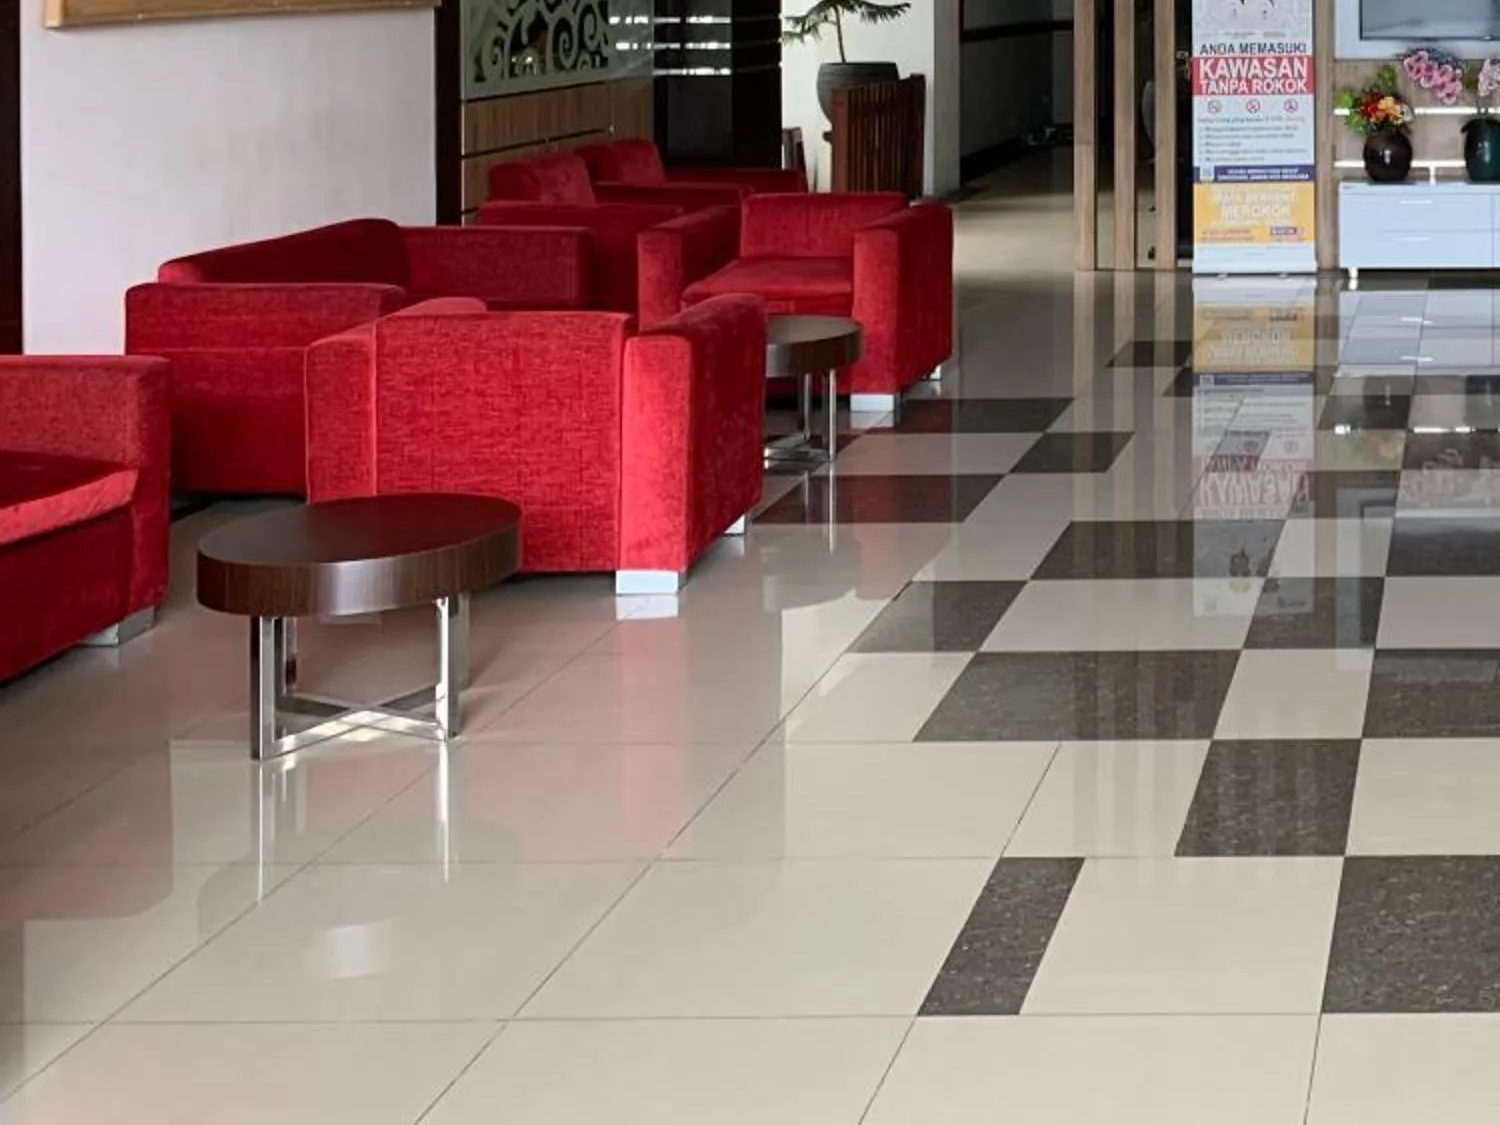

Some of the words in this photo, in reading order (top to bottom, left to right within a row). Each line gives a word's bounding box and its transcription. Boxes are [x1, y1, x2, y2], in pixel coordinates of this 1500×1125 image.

[1200, 43, 1236, 56] ANDA
[1239, 43, 1307, 55] MEMASUKI
[1200, 58, 1308, 78] KAWASAN
[1200, 79, 1248, 94] TANPA
[1252, 78, 1307, 93] ROKOK
